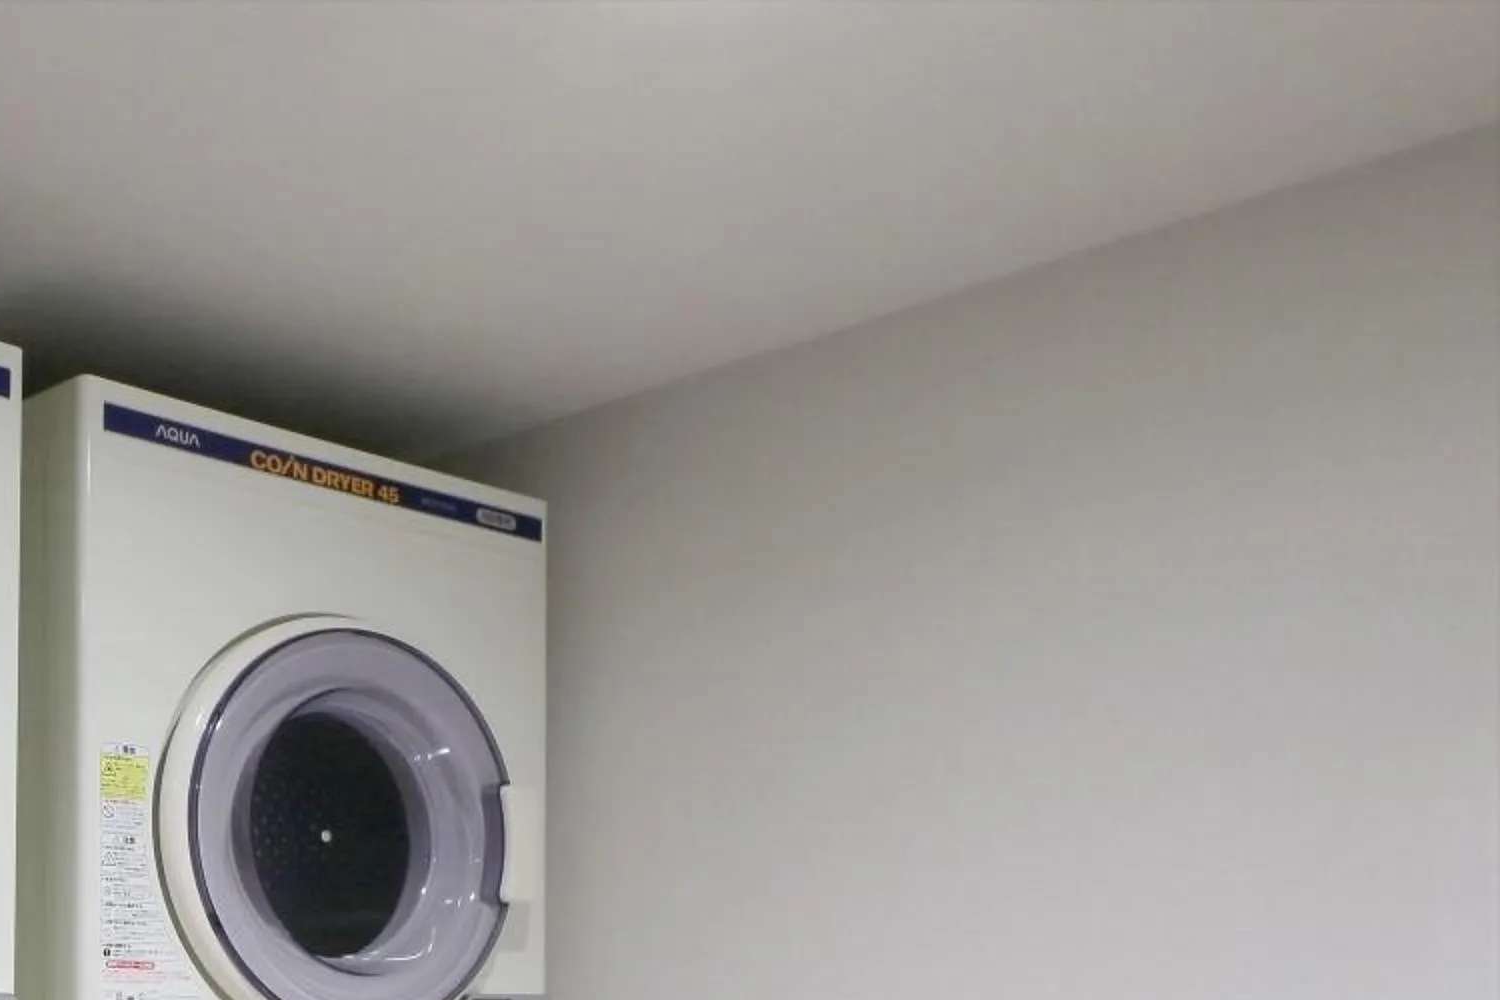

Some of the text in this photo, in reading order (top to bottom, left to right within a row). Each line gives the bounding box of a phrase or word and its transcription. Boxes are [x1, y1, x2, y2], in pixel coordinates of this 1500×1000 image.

[156, 424, 200, 448] AQUA
[312, 468, 374, 498] DRYER
[378, 485, 400, 503] 45
